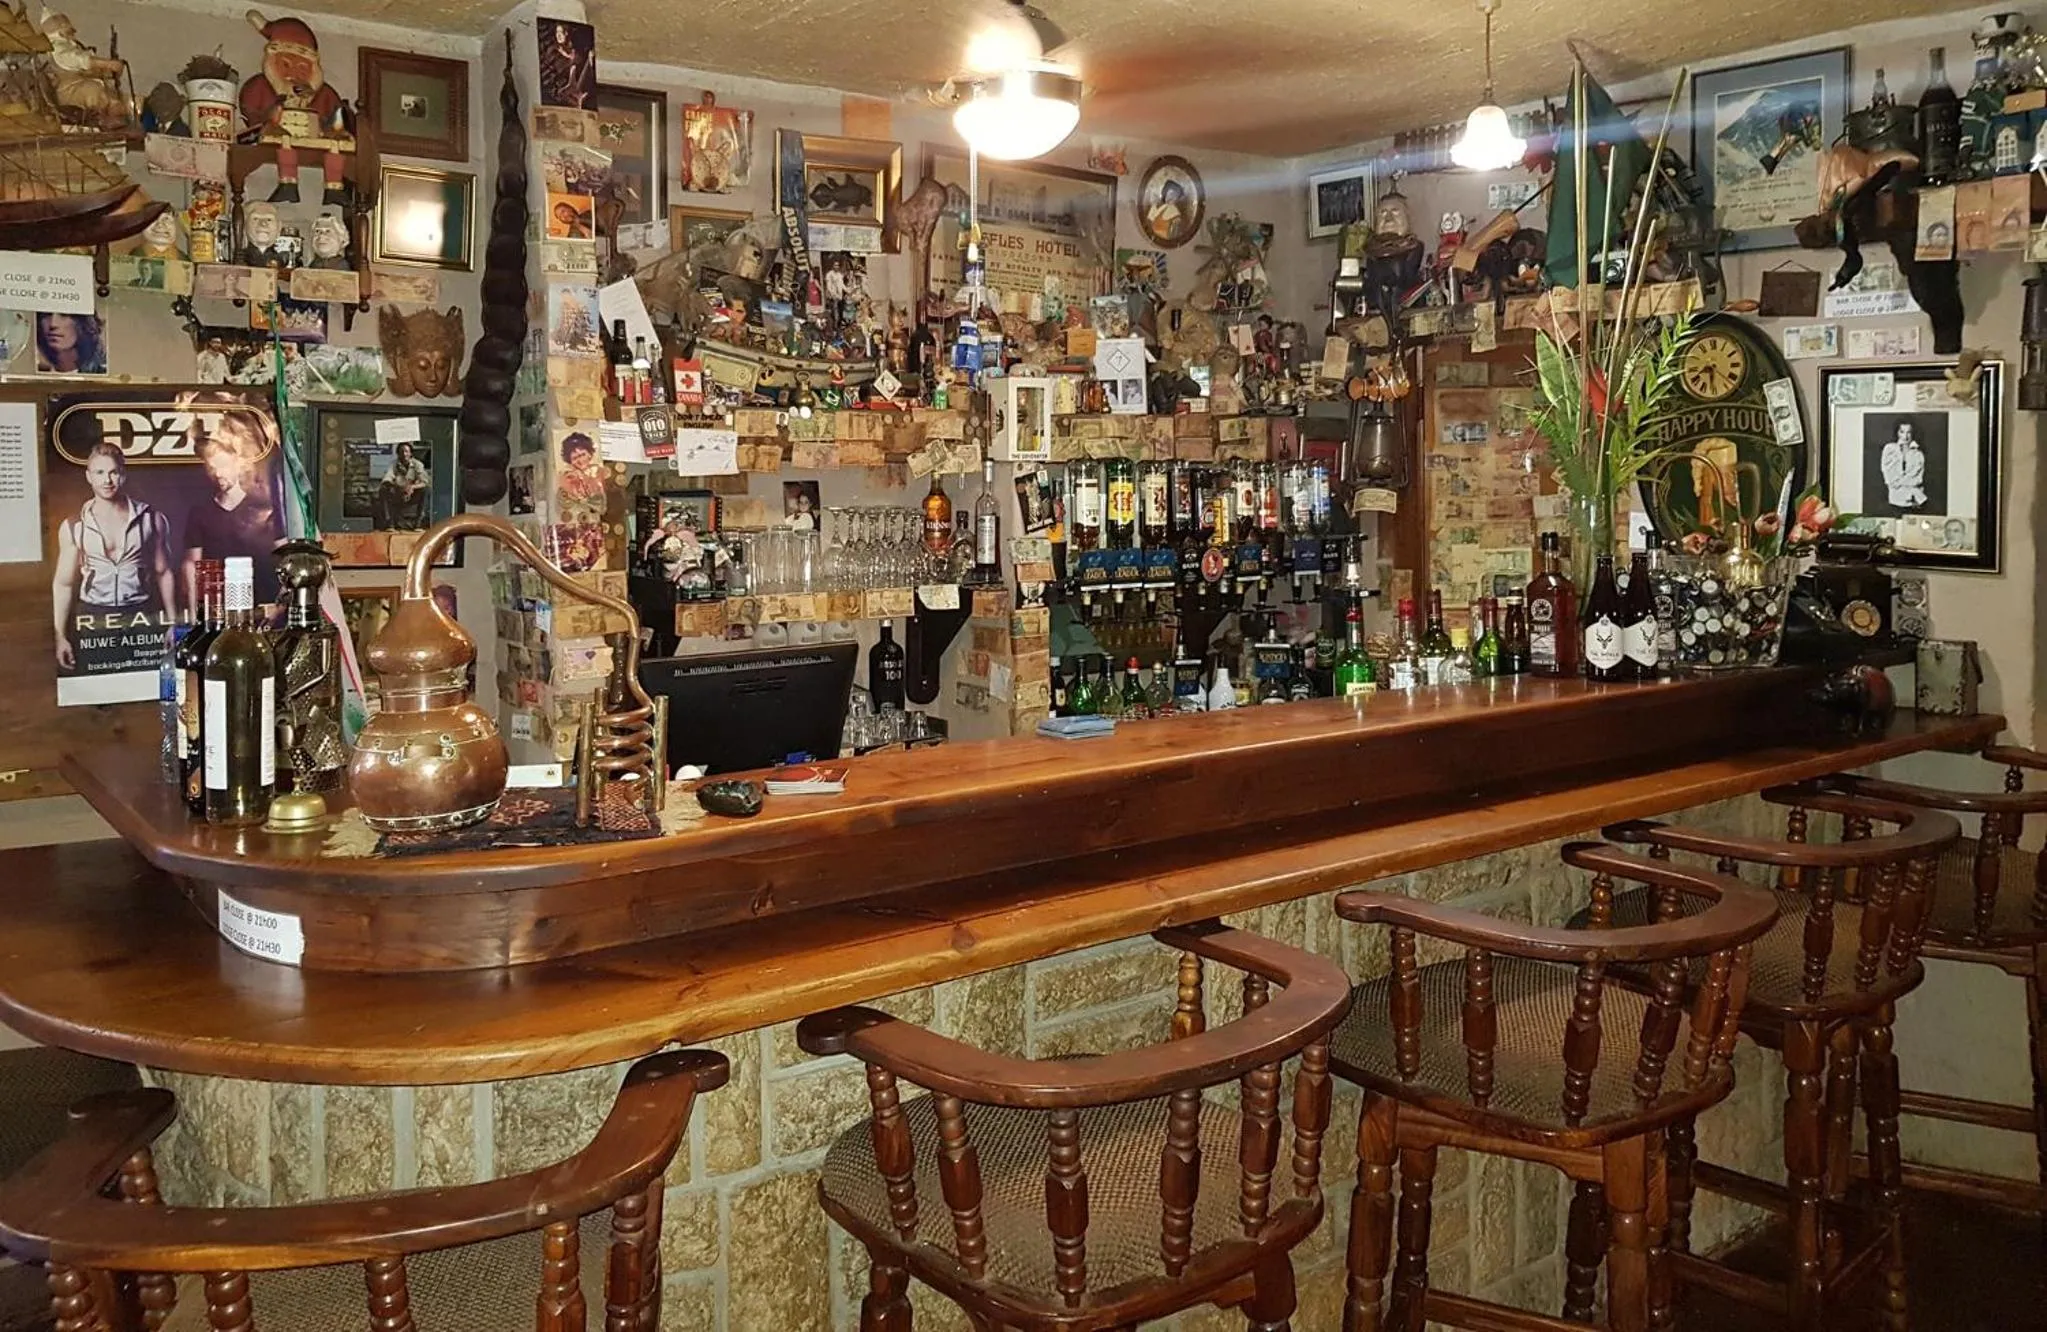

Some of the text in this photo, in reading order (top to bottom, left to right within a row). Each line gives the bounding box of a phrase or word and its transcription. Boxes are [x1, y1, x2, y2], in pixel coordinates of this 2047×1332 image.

[782, 206, 810, 272] ABSOLUT
[1035, 239, 1080, 258] HOTEL
[4, 273, 32, 282] CLOSE
[10, 288, 37, 298] CLOSE
[644, 418, 666, 432] 010
[1657, 407, 1719, 445] HAPPY
[79, 633, 165, 650] NUWE ALBUM
[256, 939, 281, 955] 21H30
